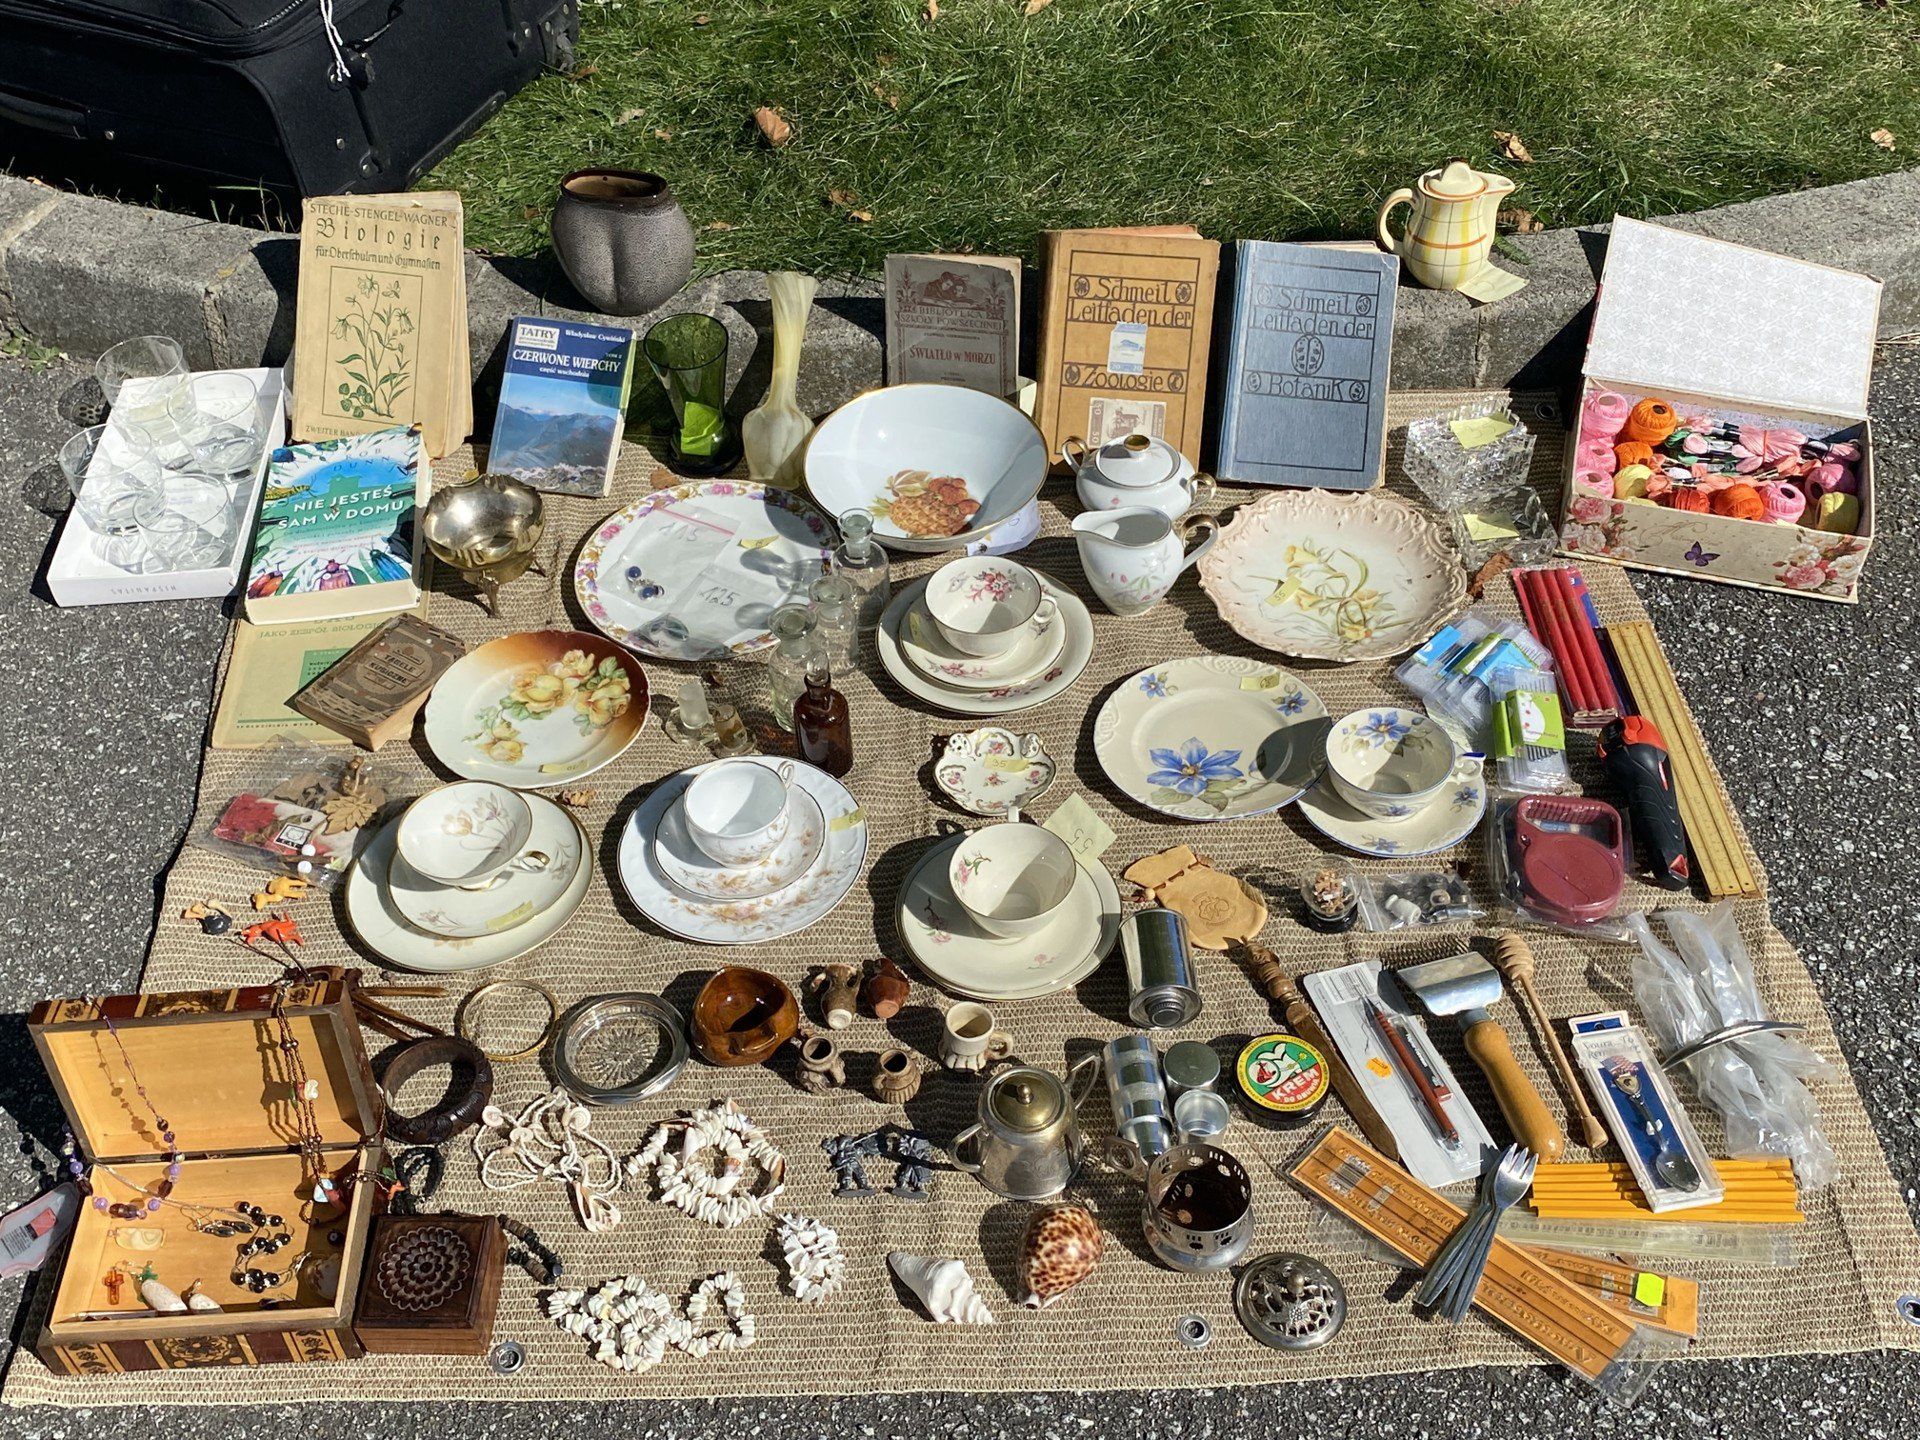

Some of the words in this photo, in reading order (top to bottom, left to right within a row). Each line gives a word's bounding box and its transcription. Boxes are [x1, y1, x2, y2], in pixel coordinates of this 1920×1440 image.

[310, 204, 448, 227] STECHE-STENGEL-WAGNER
[316, 217, 441, 250] Biologie
[315, 245, 328, 258] für
[377, 254, 394, 265] und
[1094, 275, 1171, 303] Schmeil
[1276, 285, 1350, 316] Schmeil
[1068, 299, 1159, 326] Leitfaden
[1162, 305, 1192, 328] der
[1251, 308, 1340, 337] Leitfaden
[1344, 319, 1374, 339] der
[520, 326, 557, 340] TATRY
[512, 349, 571, 367] CZERWONE
[572, 356, 621, 373] WIERCHY
[1083, 365, 1163, 391] Zoologie
[294, 499, 325, 512] NIE
[330, 484, 393, 507] JESTEŚ
[278, 516, 317, 530] SAM
[323, 510, 341, 522] W
[346, 500, 404, 520] DOMU
[260, 630, 288, 639] JAKO
[1271, 1068, 1320, 1101] KREM
